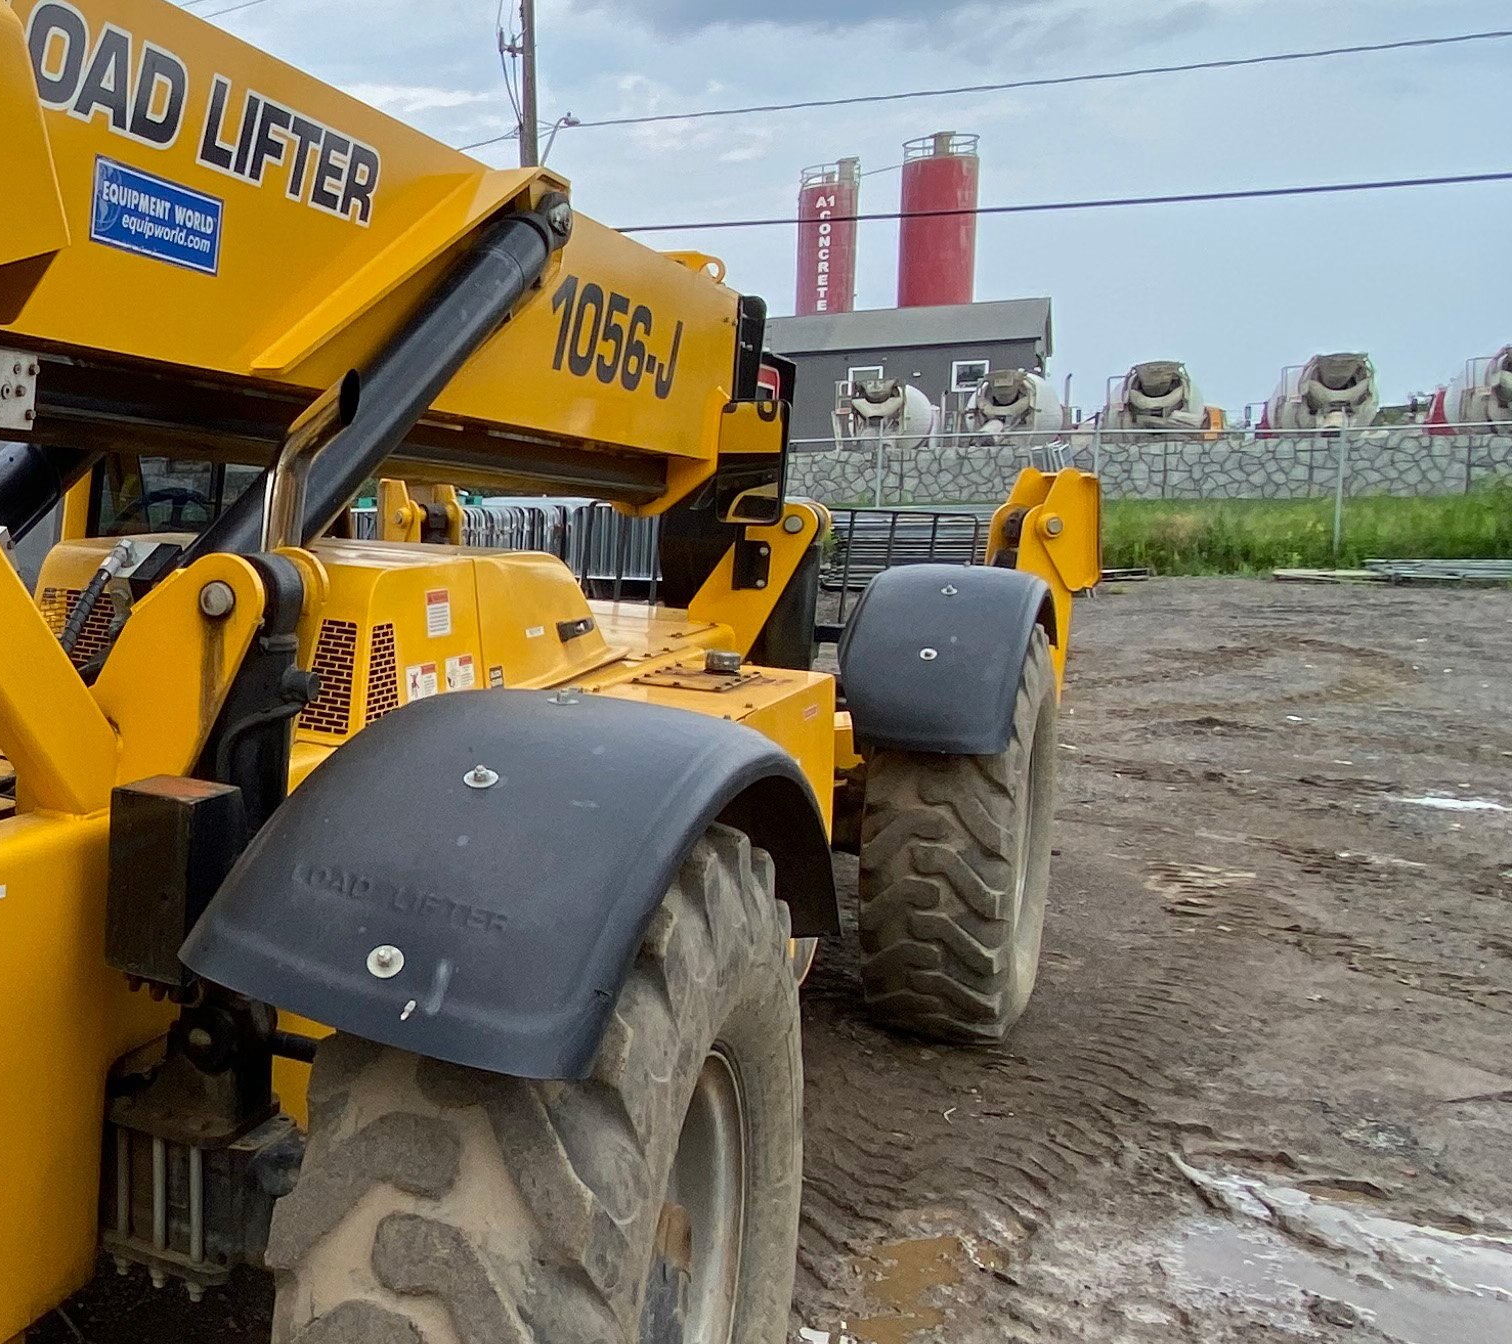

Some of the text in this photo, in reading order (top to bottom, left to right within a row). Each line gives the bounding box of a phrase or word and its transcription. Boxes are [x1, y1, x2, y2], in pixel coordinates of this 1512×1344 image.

[196, 72, 381, 229] LIFTER
[102, 180, 214, 235] EQUIPMENT WORLD
[122, 214, 211, 254] equipworld.com
[816, 195, 836, 208] A1
[816, 210, 831, 311] CONCRETE
[552, 274, 683, 399] 1056-J
